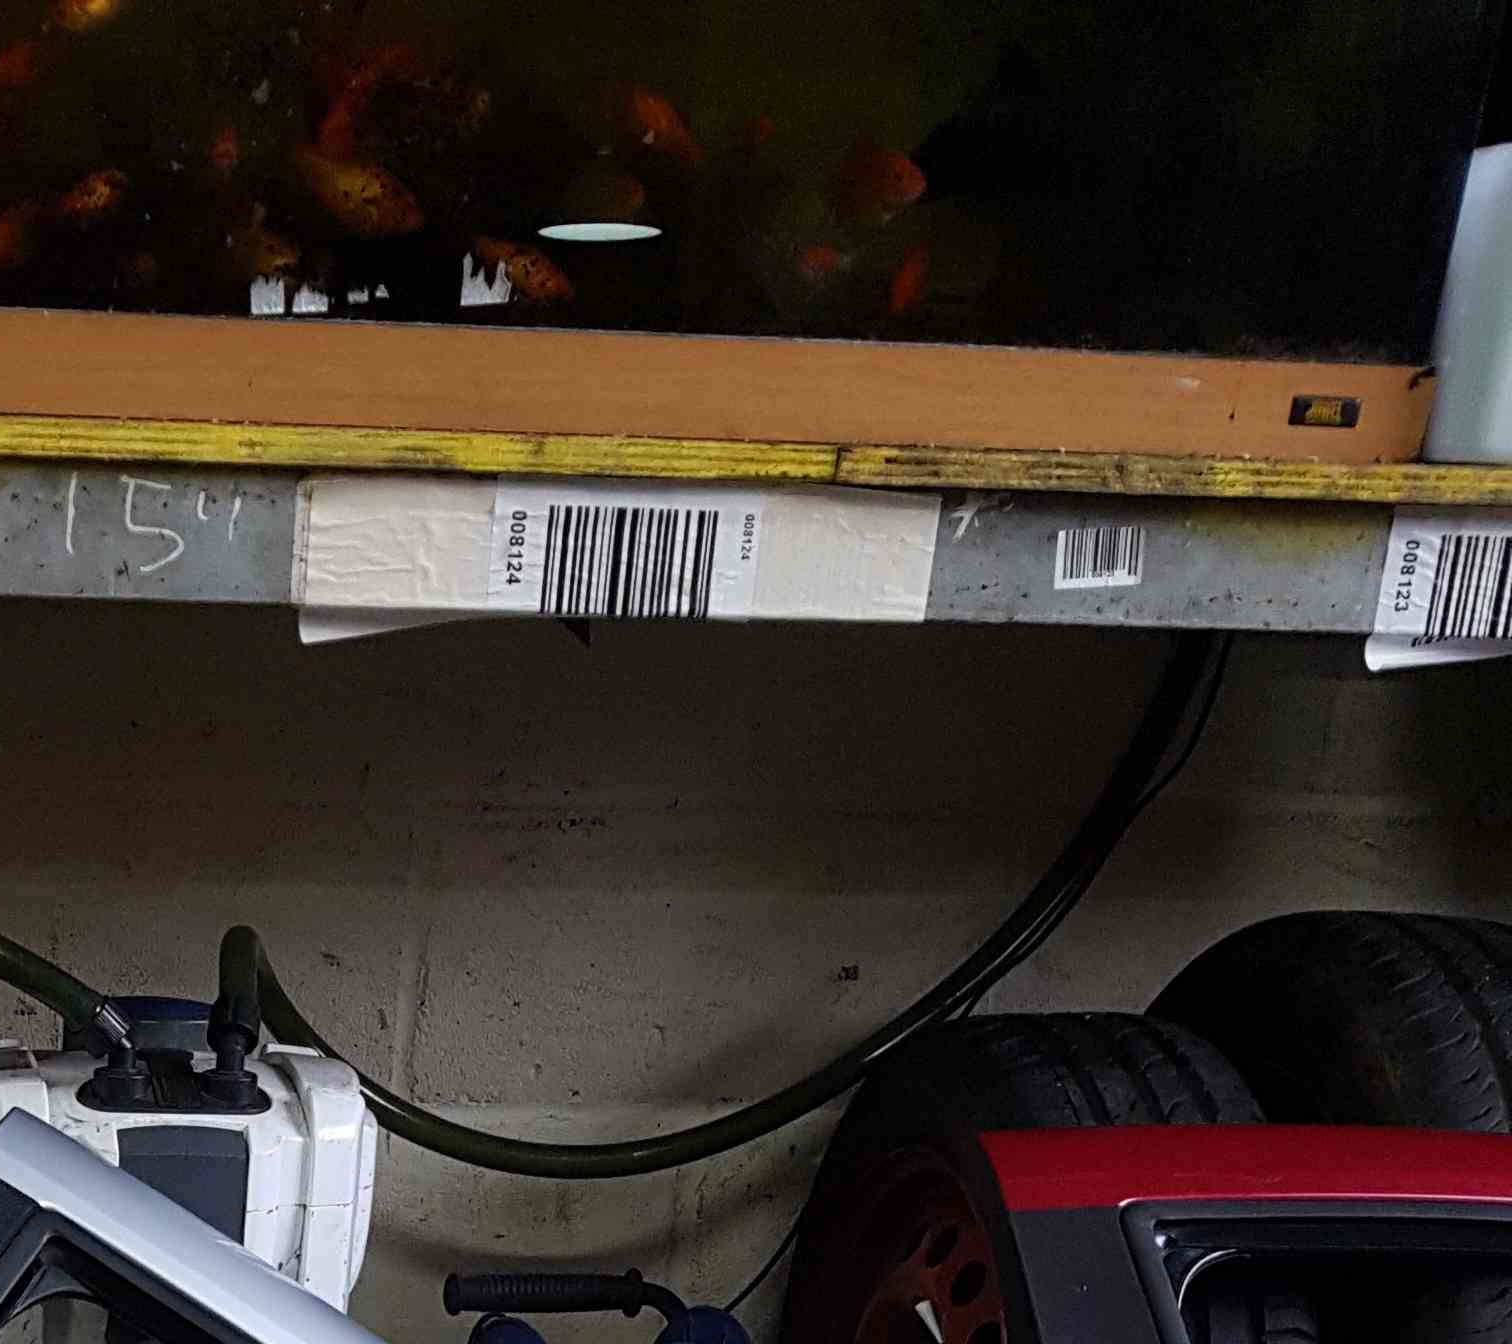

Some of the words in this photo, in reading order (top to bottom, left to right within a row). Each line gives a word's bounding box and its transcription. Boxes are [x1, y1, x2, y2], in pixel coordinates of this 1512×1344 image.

[506, 510, 528, 586] 008124
[742, 513, 755, 561] 008124
[1394, 539, 1421, 613] 008123
